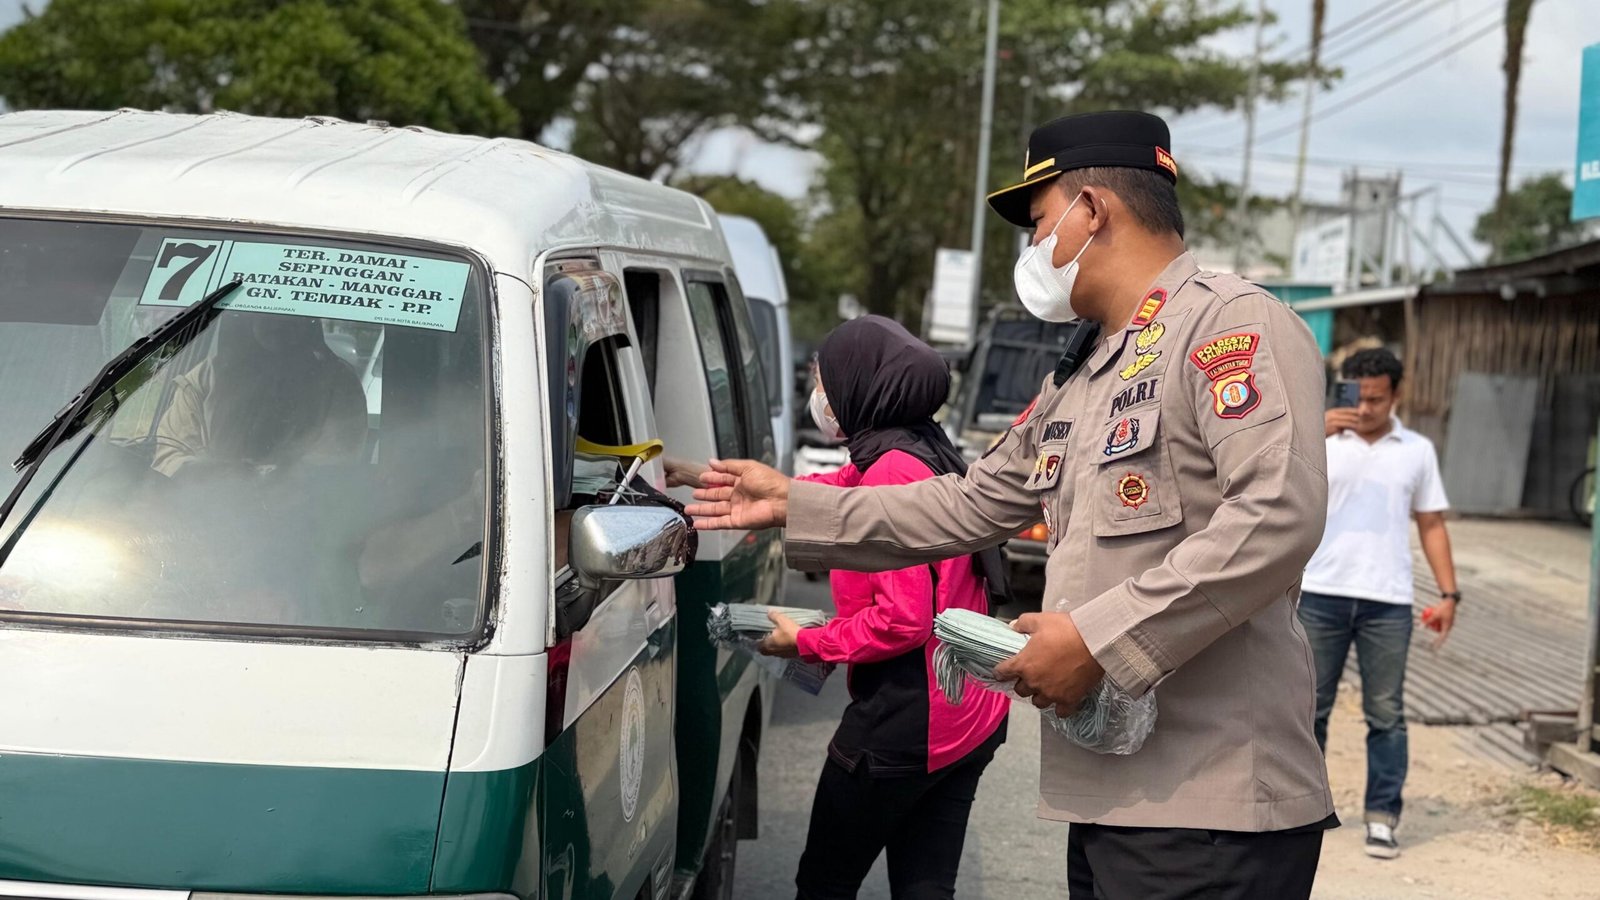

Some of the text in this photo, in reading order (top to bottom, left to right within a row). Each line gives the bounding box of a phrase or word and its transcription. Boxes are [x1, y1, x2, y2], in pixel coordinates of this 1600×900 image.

[157, 242, 217, 301] 7
[278, 261, 404, 282] SEPINGGAN
[283, 249, 331, 261] TER.
[338, 253, 408, 269] DAMAI
[231, 272, 324, 288] BATAKAN
[340, 281, 443, 301] MANGGAR
[246, 287, 282, 299] GN.
[290, 290, 383, 309] TEMBAK
[401, 301, 432, 315] P.P.
[1196, 335, 1252, 359] POLRESTA
[1201, 343, 1250, 364] BALIKPAPAN
[1109, 379, 1158, 418] POLRI
